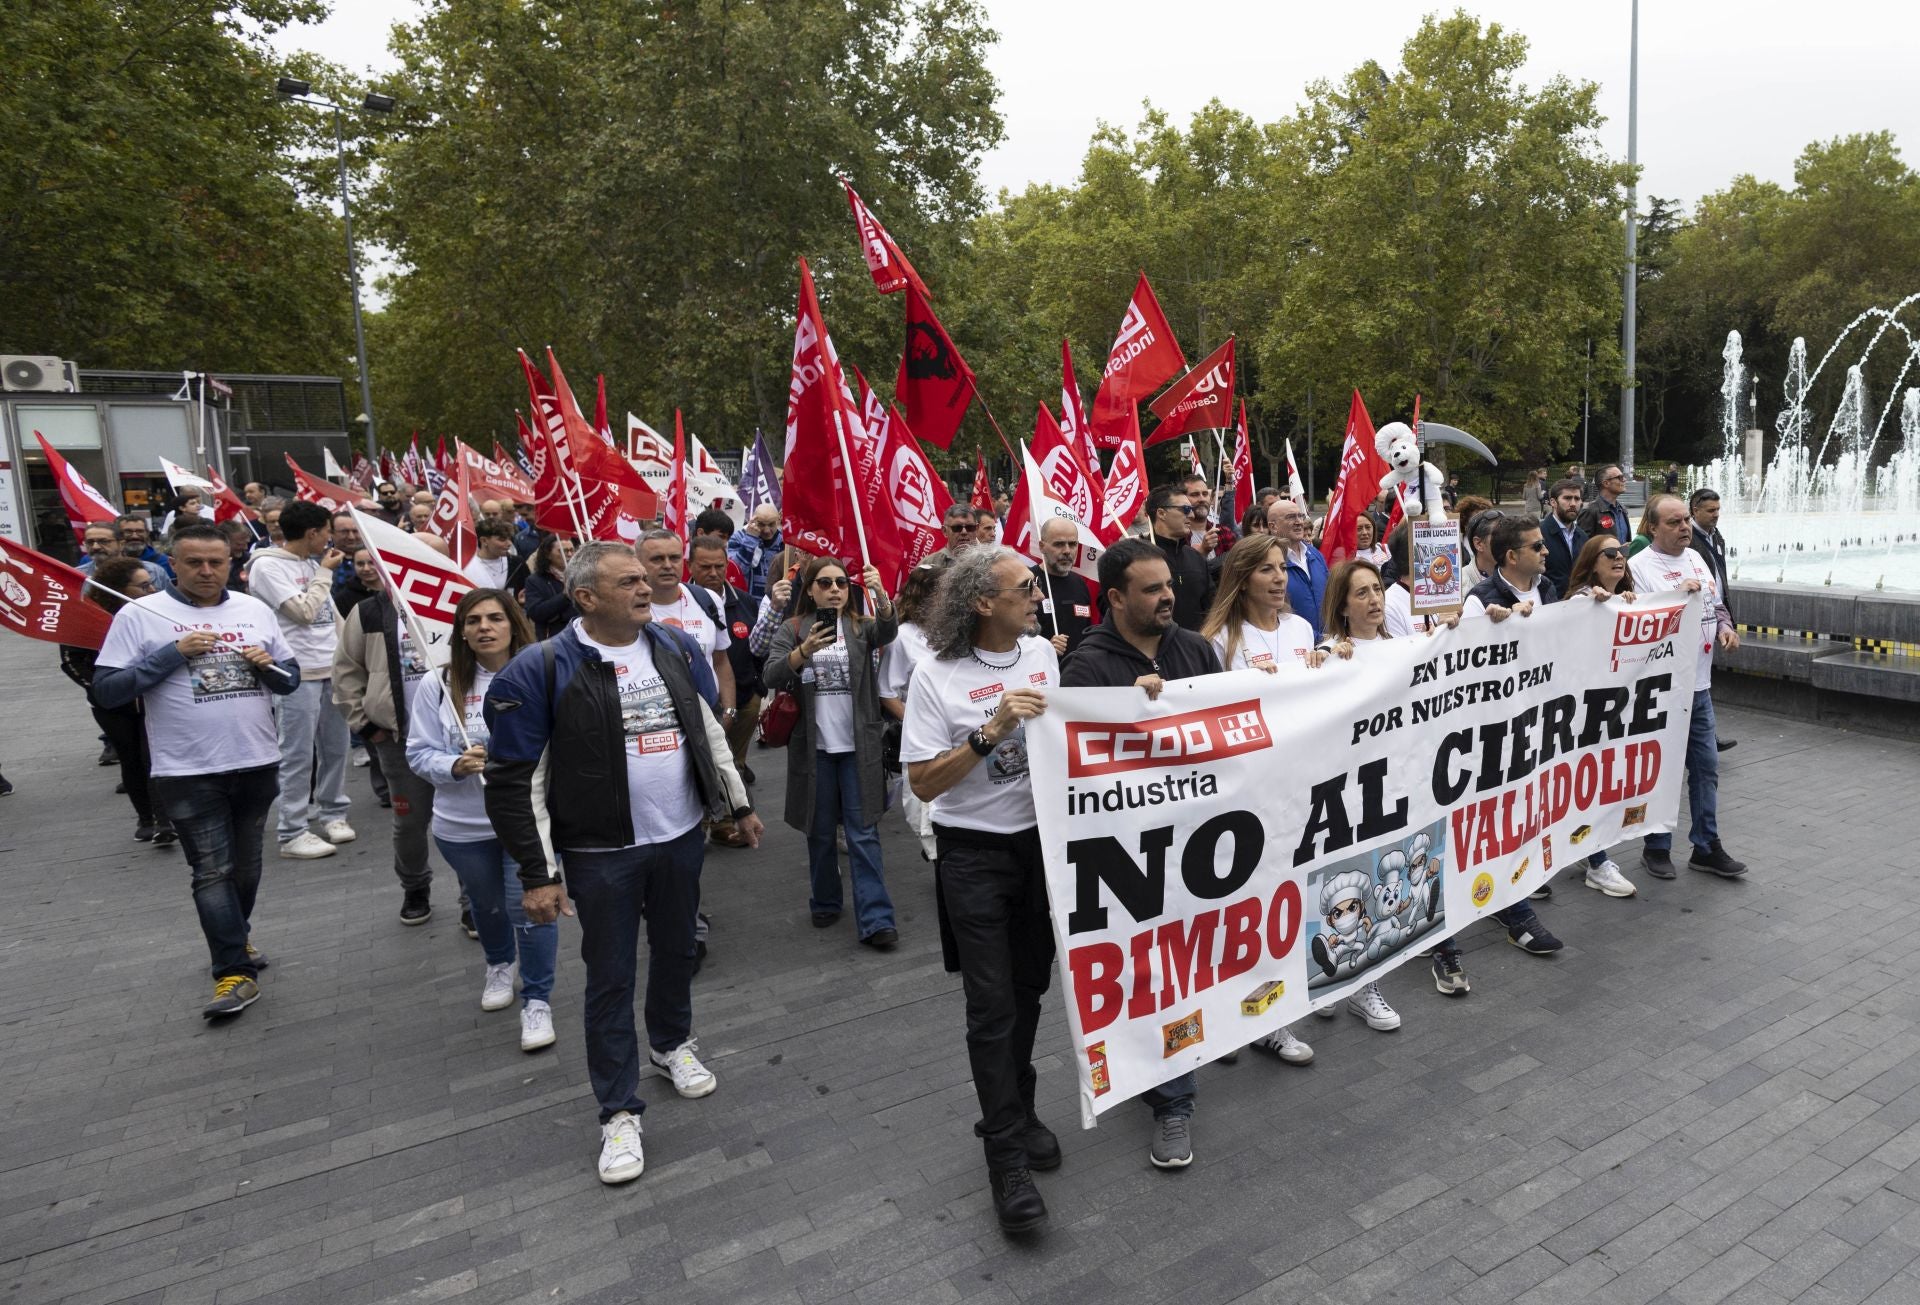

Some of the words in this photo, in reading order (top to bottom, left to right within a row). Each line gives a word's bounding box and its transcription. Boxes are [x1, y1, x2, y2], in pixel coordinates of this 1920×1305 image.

[429, 632, 442, 645] y
[1618, 611, 1670, 644] UGT
[1410, 657, 1438, 687] EN
[1444, 640, 1519, 676] LUCHA
[204, 694, 224, 703] LUCHA
[971, 687, 994, 698] CCOO
[1351, 706, 1403, 745] POR
[1412, 676, 1514, 725] NUESTRO
[1518, 662, 1553, 692] PAN
[1078, 721, 1213, 766] CCOO
[1067, 810, 1265, 936] NO
[1293, 757, 1408, 868] AL
[1432, 672, 1672, 806] CIERRE
[1068, 771, 1219, 816] industria
[1069, 880, 1302, 1035] BIMBO
[1451, 739, 1662, 873] VALLADOLID
